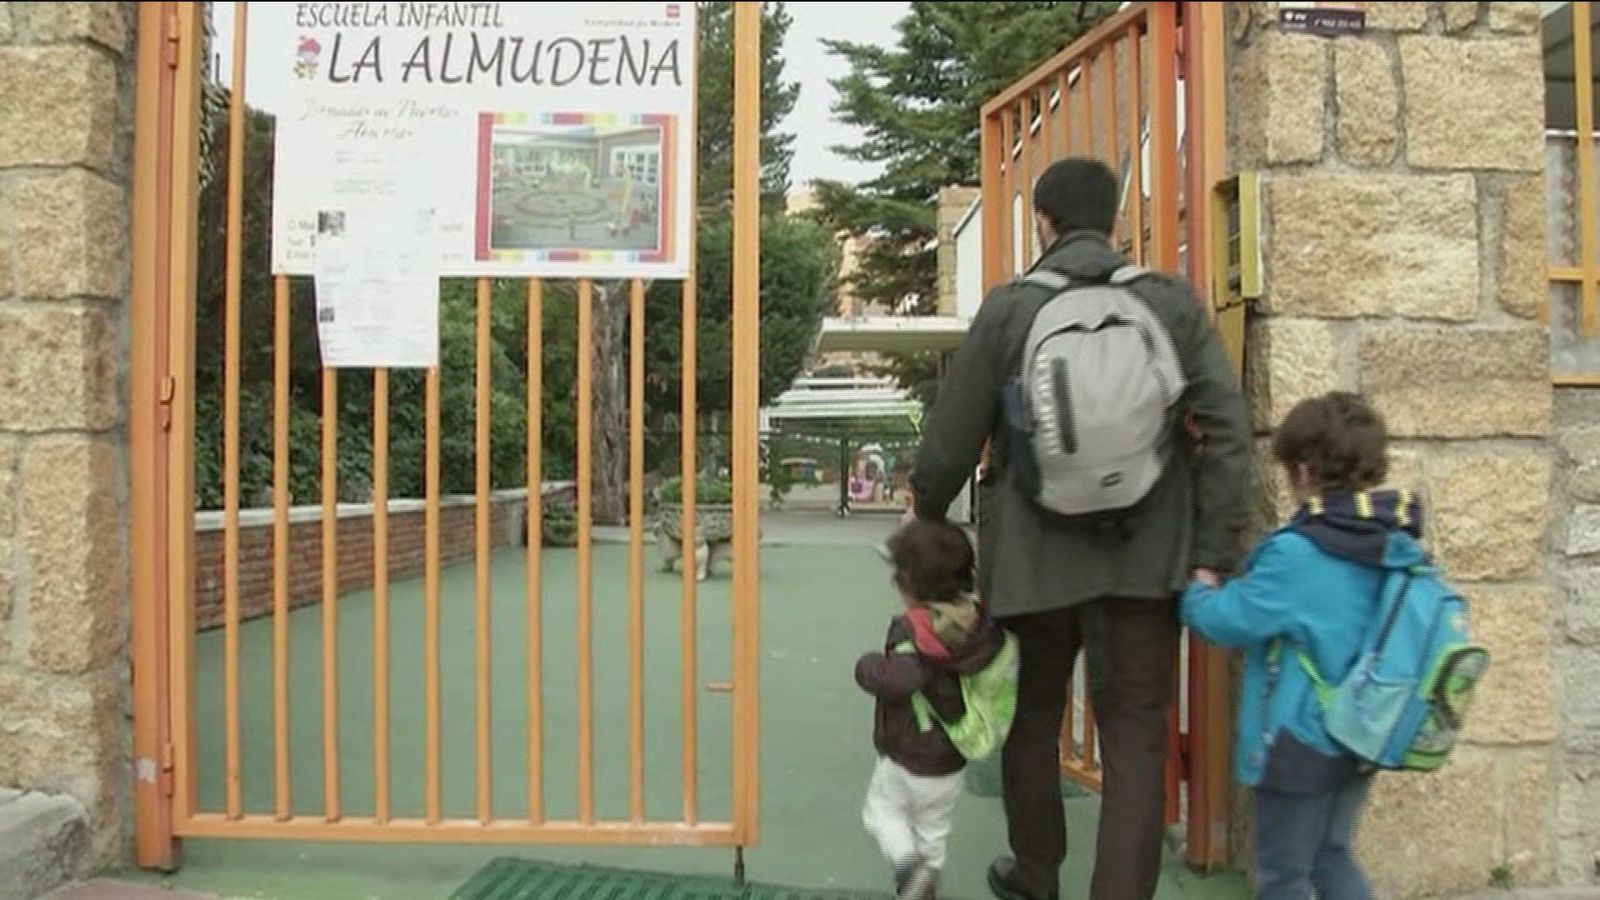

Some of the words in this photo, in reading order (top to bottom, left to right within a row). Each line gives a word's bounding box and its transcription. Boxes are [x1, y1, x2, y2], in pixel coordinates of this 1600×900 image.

[296, 3, 388, 28] ESCUELA
[396, 3, 504, 29] INFANTIL
[328, 31, 383, 84] LA
[401, 32, 682, 87] ALMUDENA
